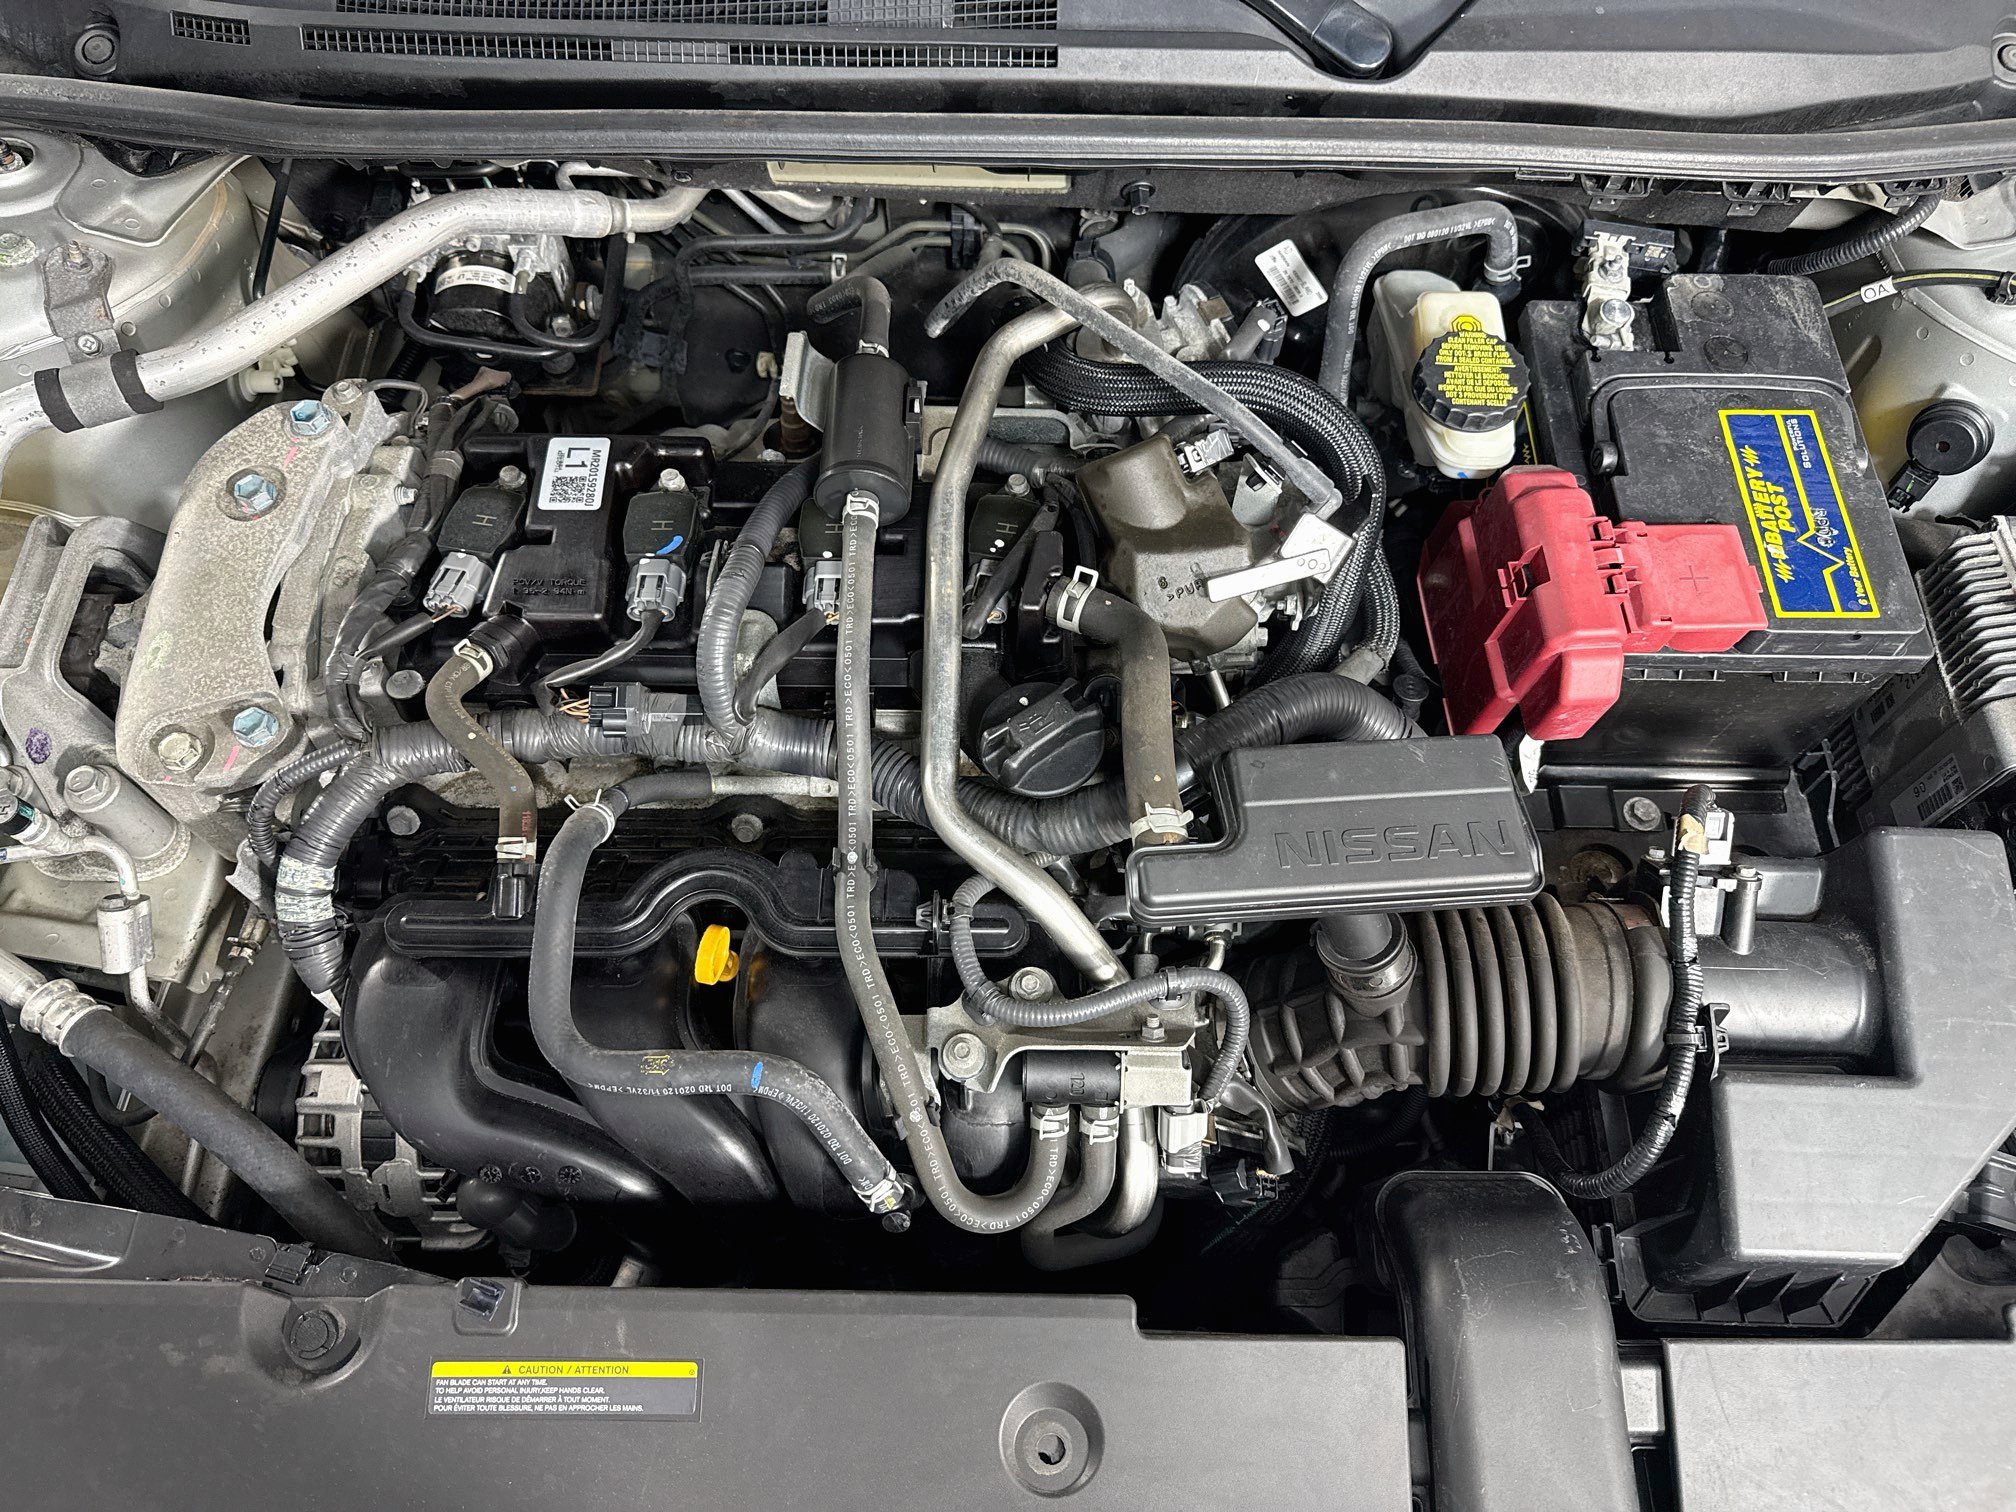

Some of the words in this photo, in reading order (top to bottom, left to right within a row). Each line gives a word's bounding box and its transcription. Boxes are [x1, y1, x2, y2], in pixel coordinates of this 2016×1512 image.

[1447, 336, 1466, 344] CLEAN
[1466, 337, 1485, 345] FILLER
[1441, 342, 1462, 350] BEFORE
[1435, 355, 1453, 363] FROM
[1444, 371, 1474, 379] NETTOYER
[1445, 378, 1466, 386] AVANT
[1474, 385, 1486, 393] QUE
[1463, 392, 1497, 400] PROVENANT
[1451, 398, 1485, 406] CONTENANT
[1785, 419, 1799, 451] POWERFUL
[1790, 418, 1812, 469] SOLUTIONS
[565, 447, 591, 468] L1
[584, 449, 602, 507] MR20159280J
[1745, 466, 1784, 546] BATTERY
[1766, 481, 1797, 533] POST
[1843, 547, 1860, 577] Battery
[1853, 577, 1865, 598] Year
[1858, 598, 1868, 606] 6
[1274, 819, 1515, 869] NISSAN
[662, 1085, 696, 1095] 020120
[716, 1083, 732, 1093] DOT
[808, 1112, 832, 1139] 020120
[908, 1092, 944, 1182] TRD>ECO<501
[836, 1150, 853, 1165] DOT
[518, 1365, 564, 1375] CAUTION
[574, 1365, 629, 1375] ATTENTION
[436, 1378, 448, 1386] FAN
[449, 1378, 471, 1386] BLADE
[472, 1378, 486, 1386] CAN
[487, 1378, 507, 1386] START
[508, 1378, 517, 1386] AT
[517, 1378, 531, 1386] ANY
[532, 1378, 548, 1386] TIME.
[521, 1395, 556, 1403] DÉMARRER
[433, 1404, 453, 1412] POUR
[453, 1403, 475, 1412] ÉVITER
[476, 1404, 497, 1412] TOUTE
[498, 1404, 533, 1412] BLESSURE,
[534, 1404, 544, 1412] NE
[544, 1404, 557, 1412] PAS
[558, 1404, 567, 1412] EN
[568, 1404, 608, 1412] APPROCHER
[609, 1404, 621, 1412] LES
[622, 1404, 644, 1412] MAINS.
